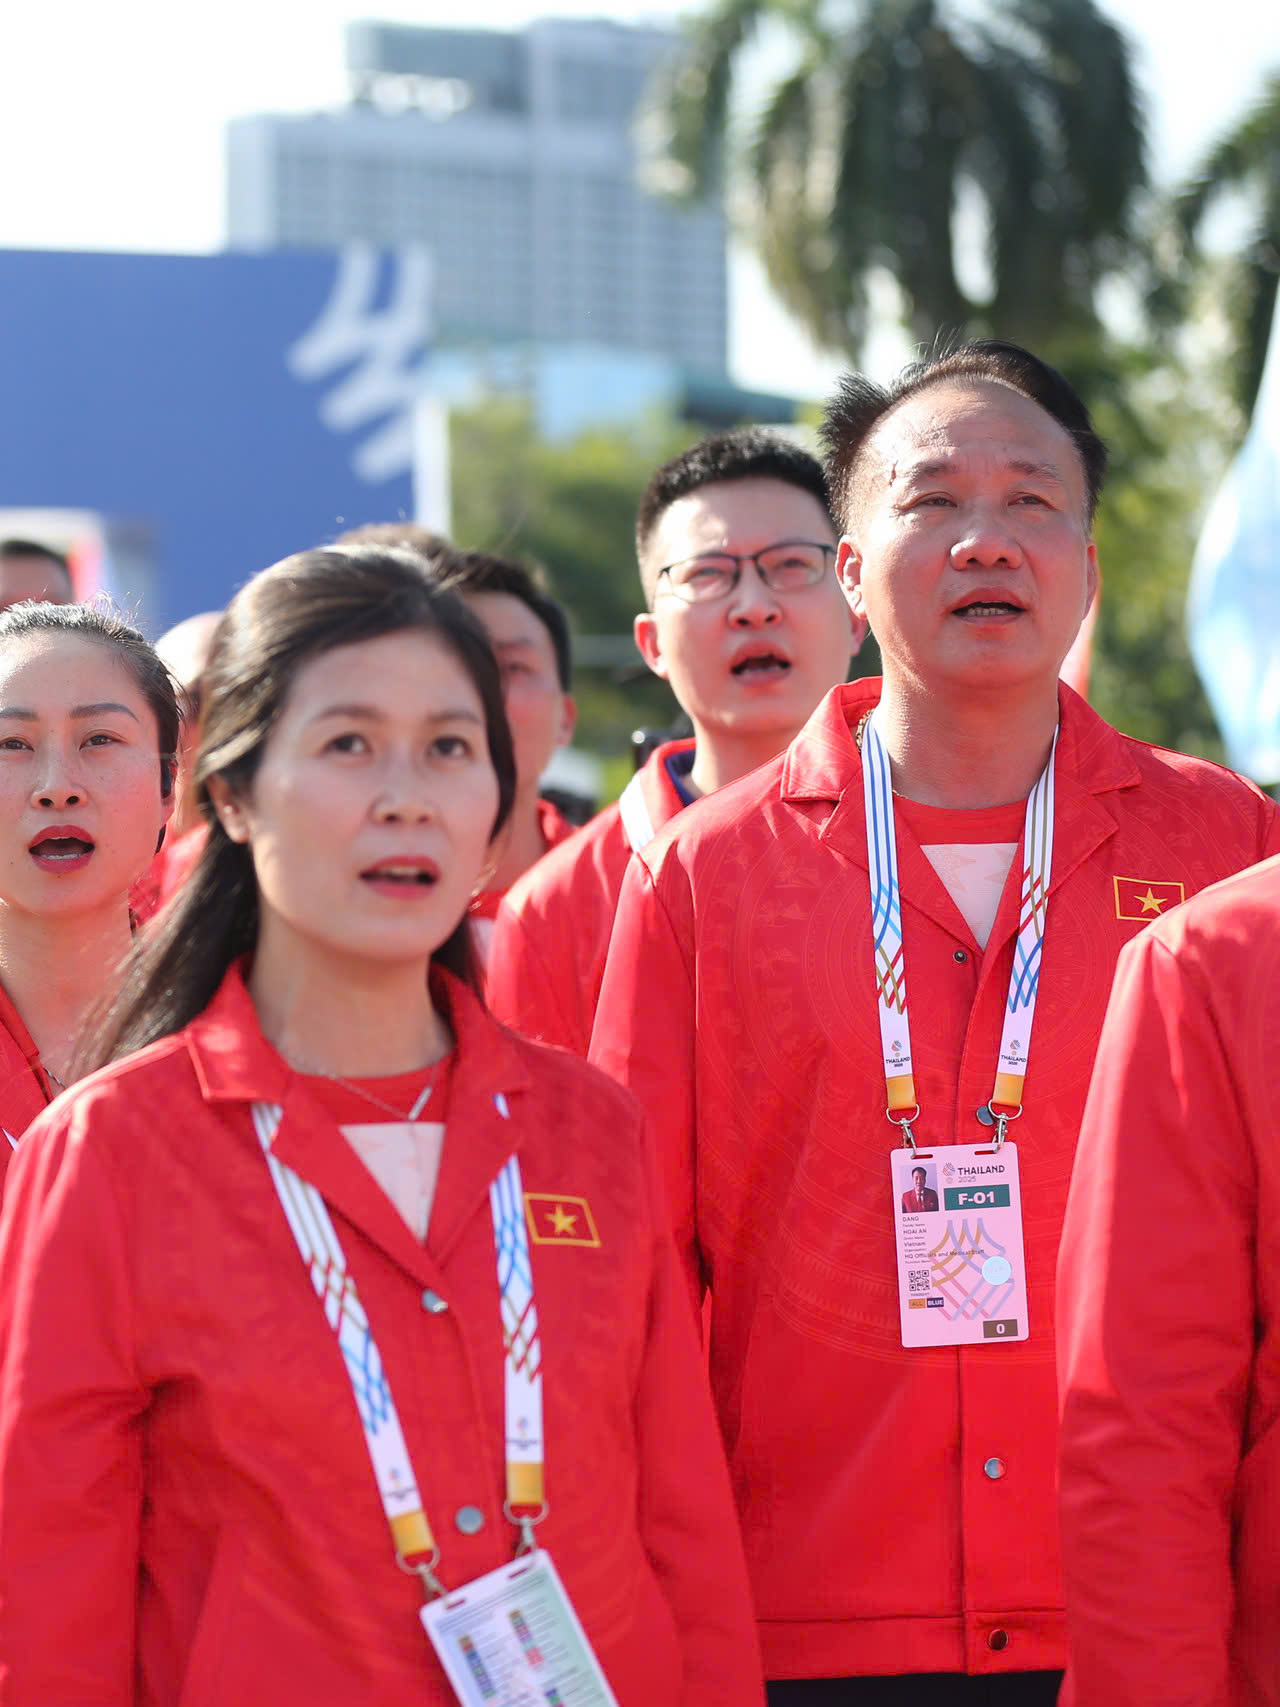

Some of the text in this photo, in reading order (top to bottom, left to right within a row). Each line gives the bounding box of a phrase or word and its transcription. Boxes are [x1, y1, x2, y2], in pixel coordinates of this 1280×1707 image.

[885, 1056, 910, 1064] THAILAND
[1001, 1055, 1026, 1063] THAILAND
[958, 1165, 1005, 1175] THAILAND
[996, 1323, 1005, 1334] 0
